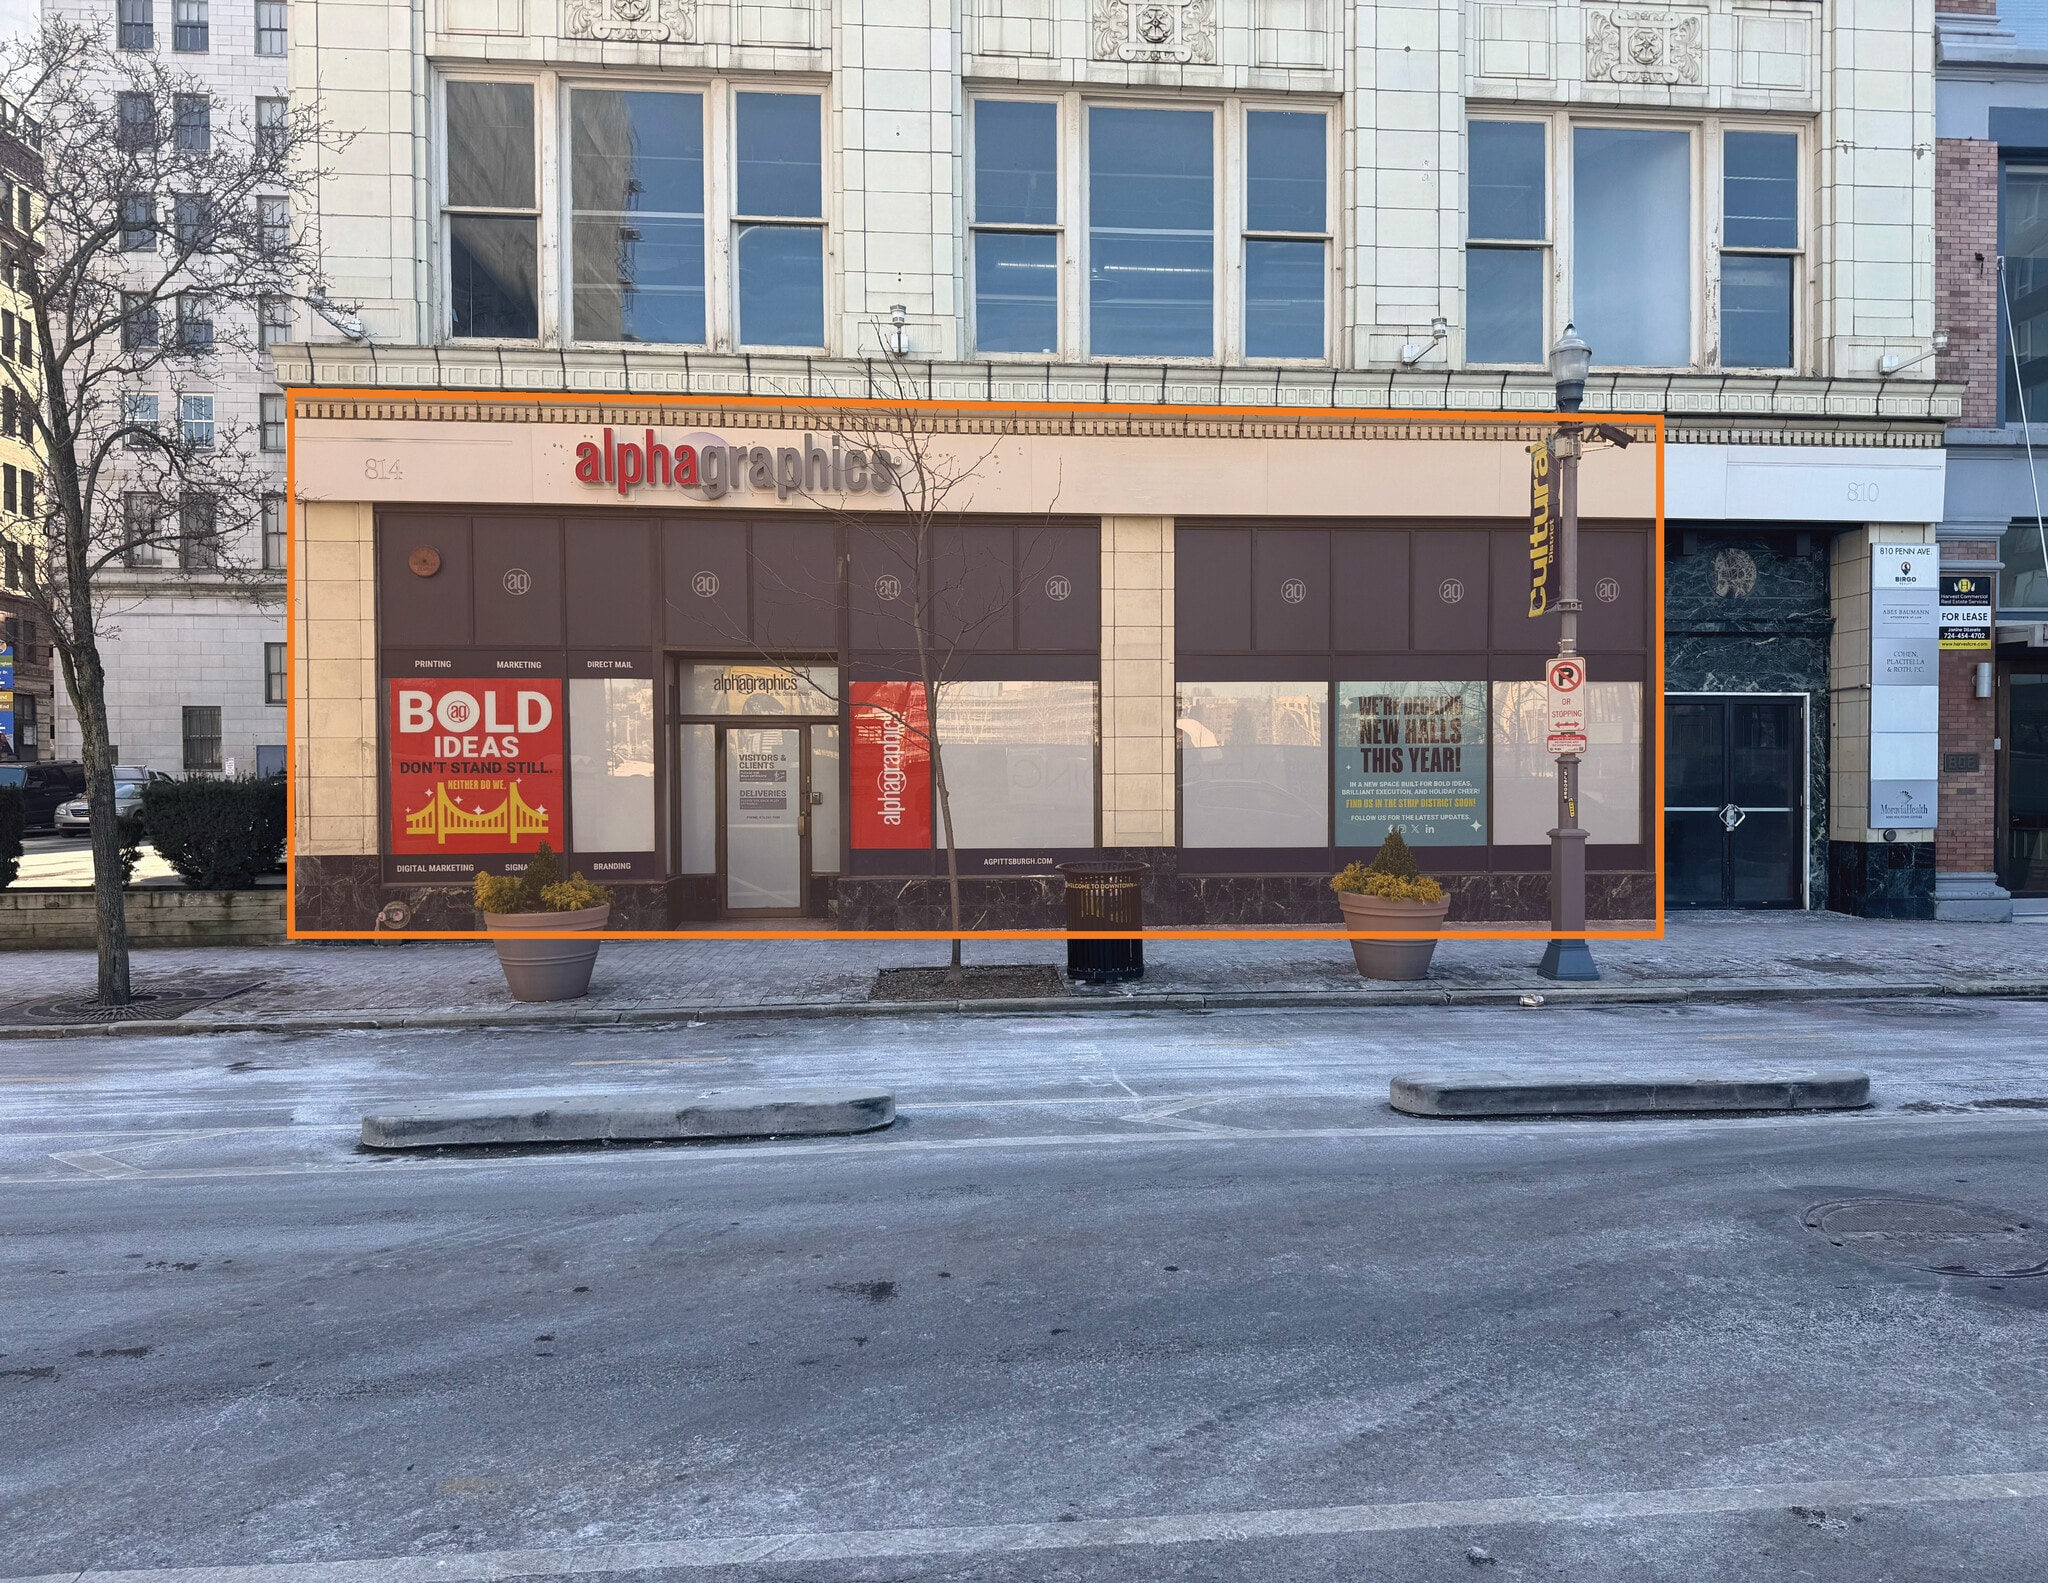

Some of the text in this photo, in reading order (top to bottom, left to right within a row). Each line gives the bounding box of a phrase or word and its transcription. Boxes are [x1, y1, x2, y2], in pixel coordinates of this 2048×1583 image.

[364, 458, 403, 480] 814
[1848, 482, 1879, 502] 810
[497, 661, 542, 669] MARKETING
[587, 660, 611, 668] DIRECT
[714, 674, 798, 694] alphagraphics
[399, 690, 552, 733] BOLD
[1359, 696, 1463, 715] WE'RE DECKING
[1552, 710, 1582, 718] STOPPING
[1360, 718, 1462, 744] NEW HALLS
[434, 736, 519, 758] IDEAS
[1361, 747, 1461, 773] THIS YEAR!
[400, 762, 552, 774] DON'T STAND STILL.
[878, 711, 905, 826] alphagraphics
[448, 780, 506, 790] NEITHER DO WE.
[1346, 798, 1476, 808] FIND US IN THE STRIP DISTRICT SOON!
[397, 864, 474, 873] DIGITAL MARKETING
[594, 862, 631, 870] BRANDING
[984, 857, 1053, 866] AGPITTSBURGH.COM
